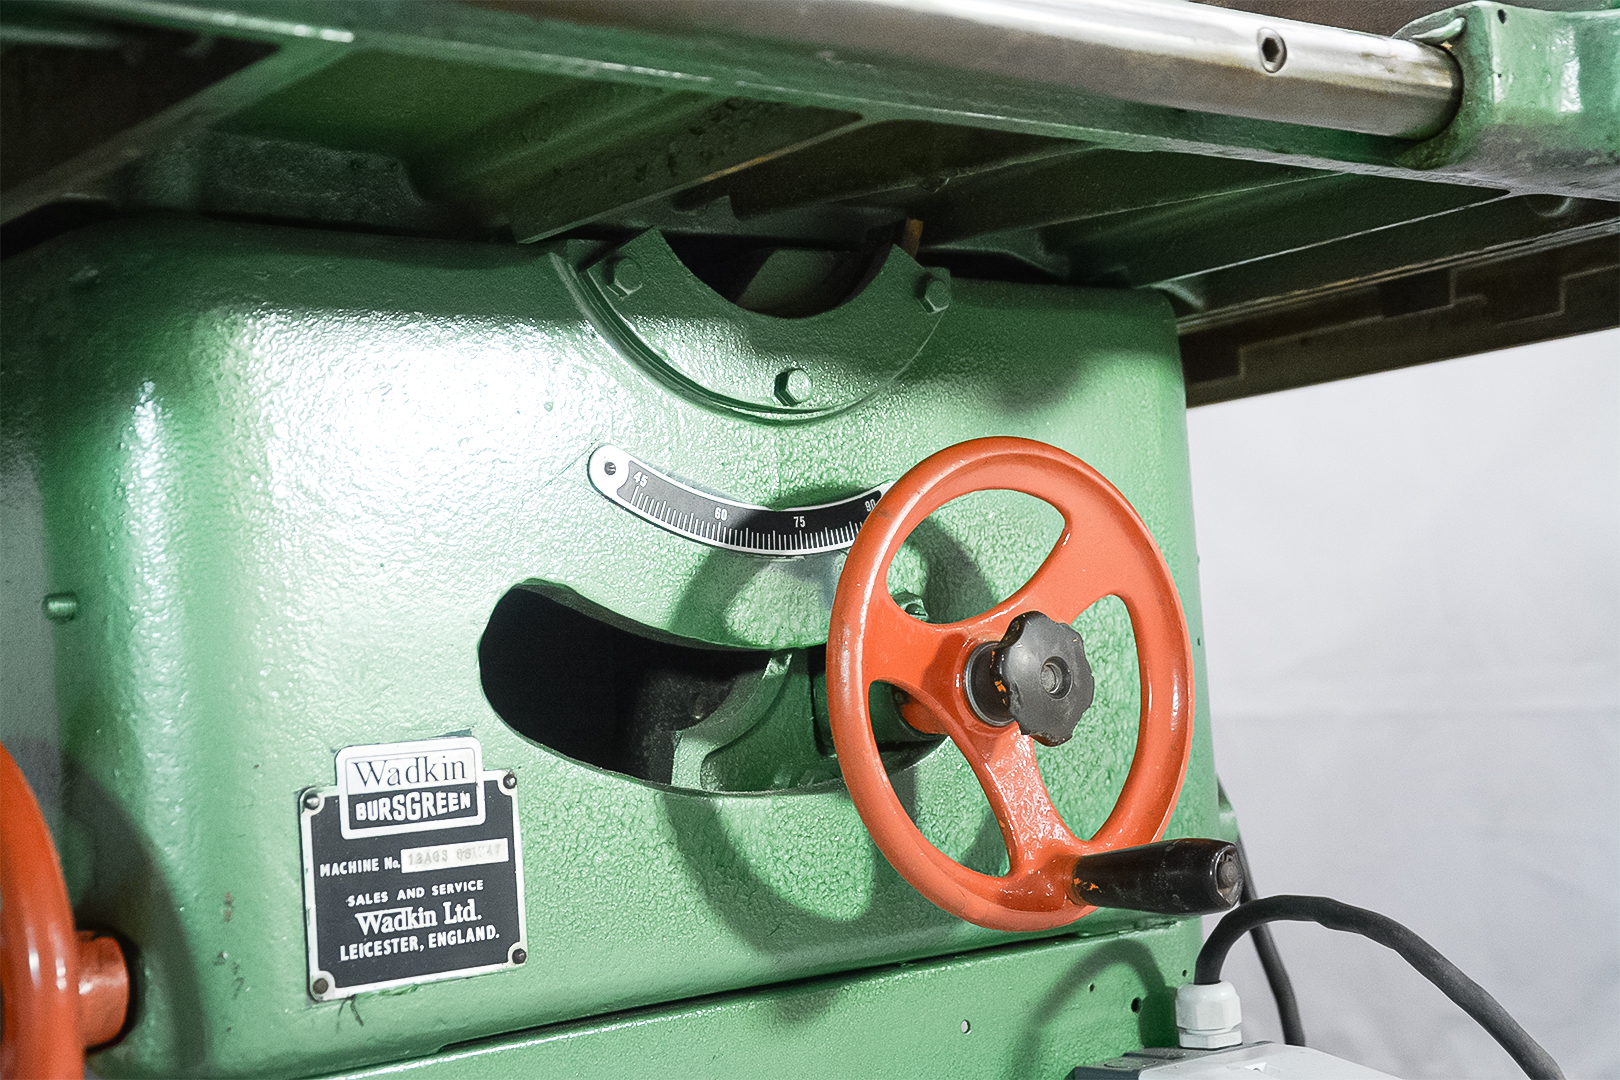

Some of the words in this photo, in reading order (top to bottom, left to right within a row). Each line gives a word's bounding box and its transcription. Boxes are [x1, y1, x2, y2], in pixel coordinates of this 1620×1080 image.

[633, 471, 648, 488] 45
[714, 507, 728, 521] 60
[793, 516, 806, 529] 75
[353, 755, 467, 787] Wadkin
[355, 790, 471, 821] BURSGREEN
[319, 858, 380, 877] MACHINE
[384, 856, 400, 870] No.
[346, 891, 389, 907] SALES
[397, 887, 425, 901] AND
[431, 879, 484, 896] SERVICE
[354, 906, 438, 935] Wadkin
[442, 898, 482, 925] Ltd.
[340, 936, 425, 961] LEICESTER,
[428, 924, 500, 949] ENGLAND.
